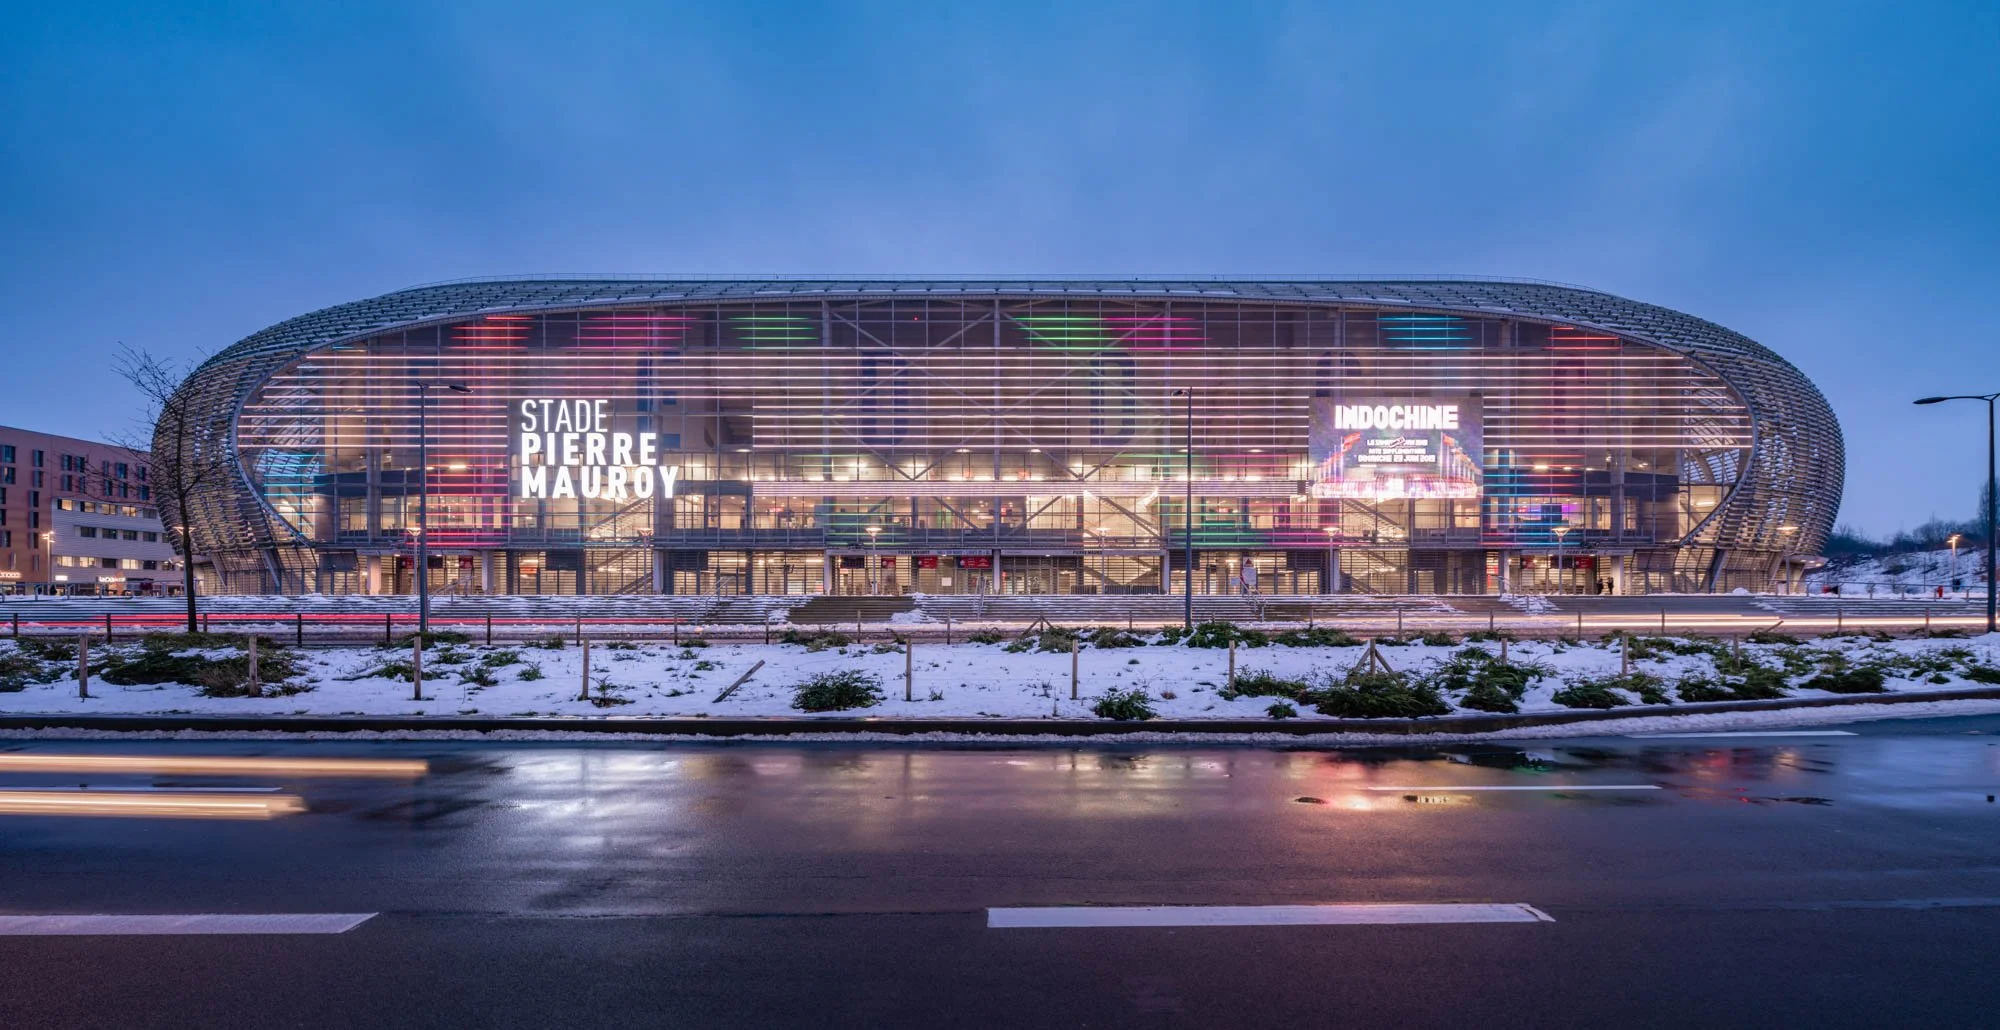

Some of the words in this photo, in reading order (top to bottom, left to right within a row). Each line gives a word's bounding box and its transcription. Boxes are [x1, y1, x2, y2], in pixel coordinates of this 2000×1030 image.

[521, 399, 607, 432] STADE
[1335, 405, 1458, 429] INDOCHINE
[521, 433, 657, 465] PIERRE
[521, 465, 679, 498] MAUROY
